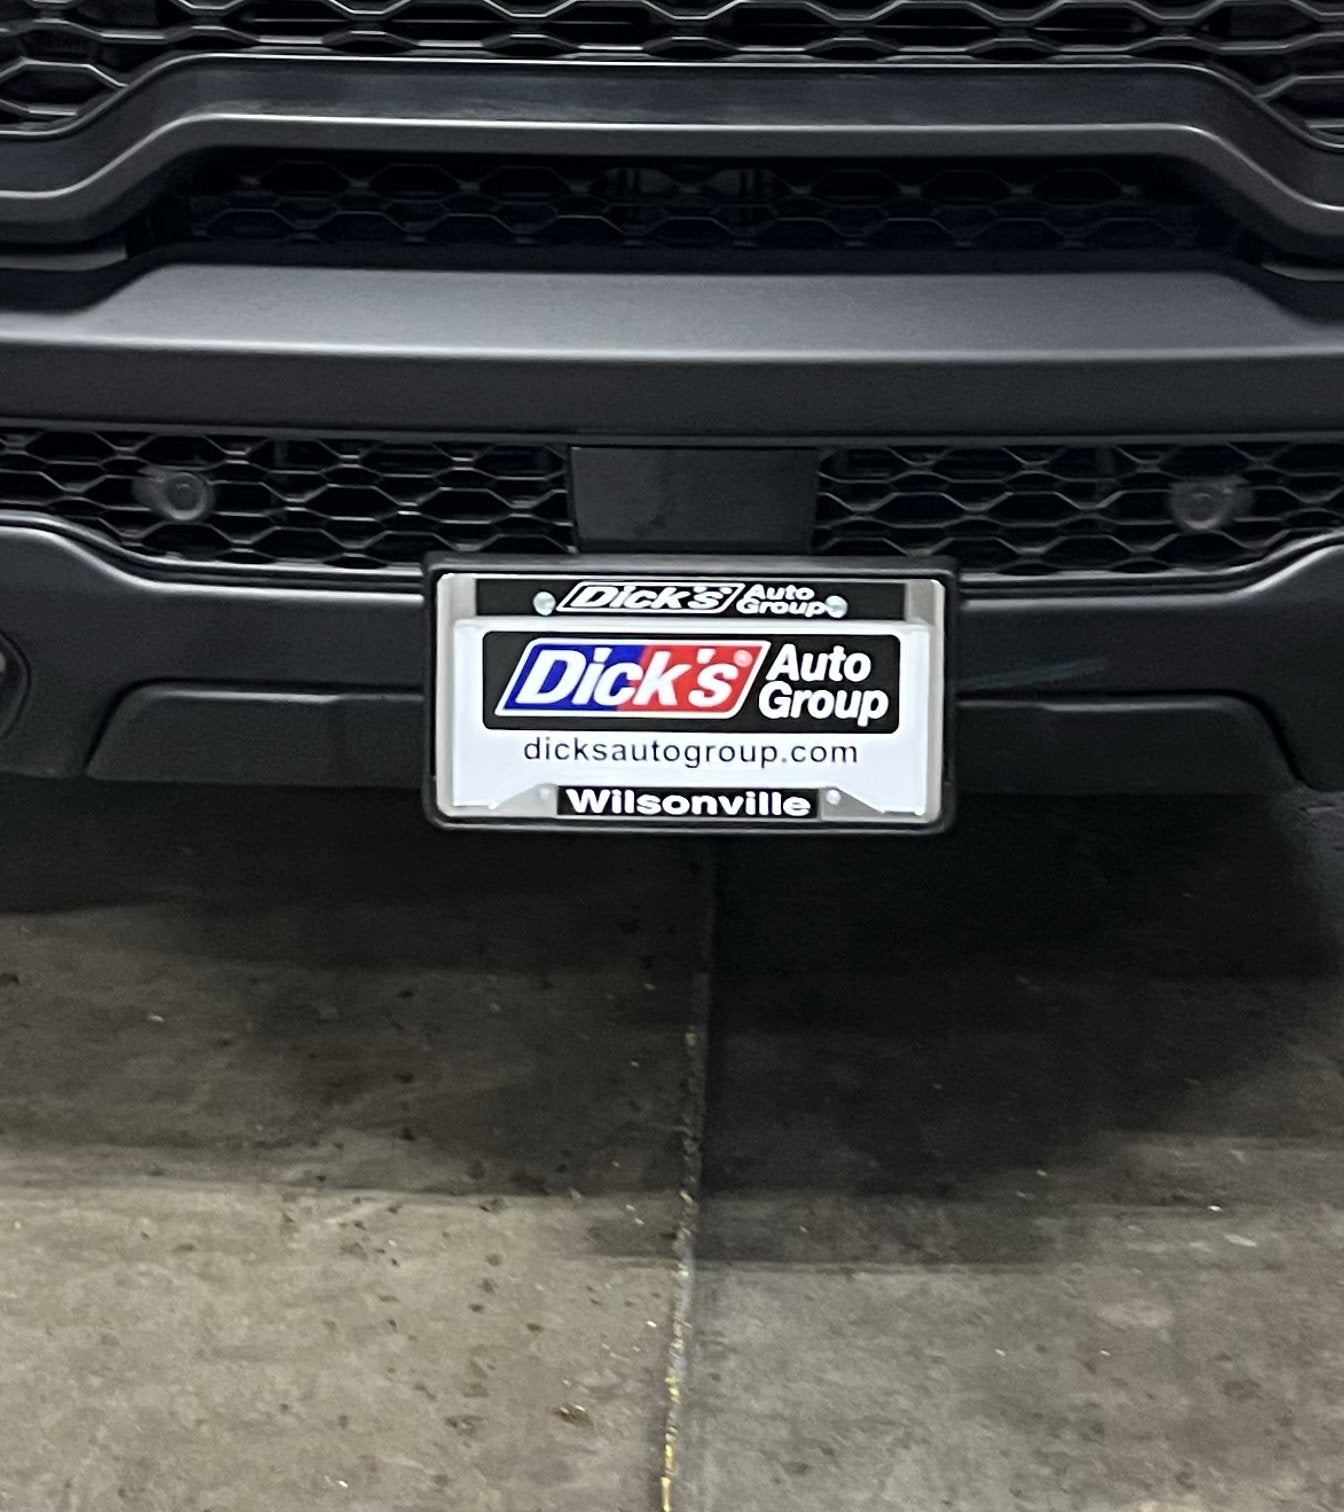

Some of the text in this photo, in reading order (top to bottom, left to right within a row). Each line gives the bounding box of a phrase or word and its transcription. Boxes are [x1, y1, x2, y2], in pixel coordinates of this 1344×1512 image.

[569, 584, 815, 609] Dick's Auto
[736, 598, 828, 617] Group
[515, 643, 872, 708] Dick's Auto
[758, 680, 889, 727] Group
[523, 736, 858, 768] dicksautogroup.com
[564, 788, 812, 817] Wilsonville
